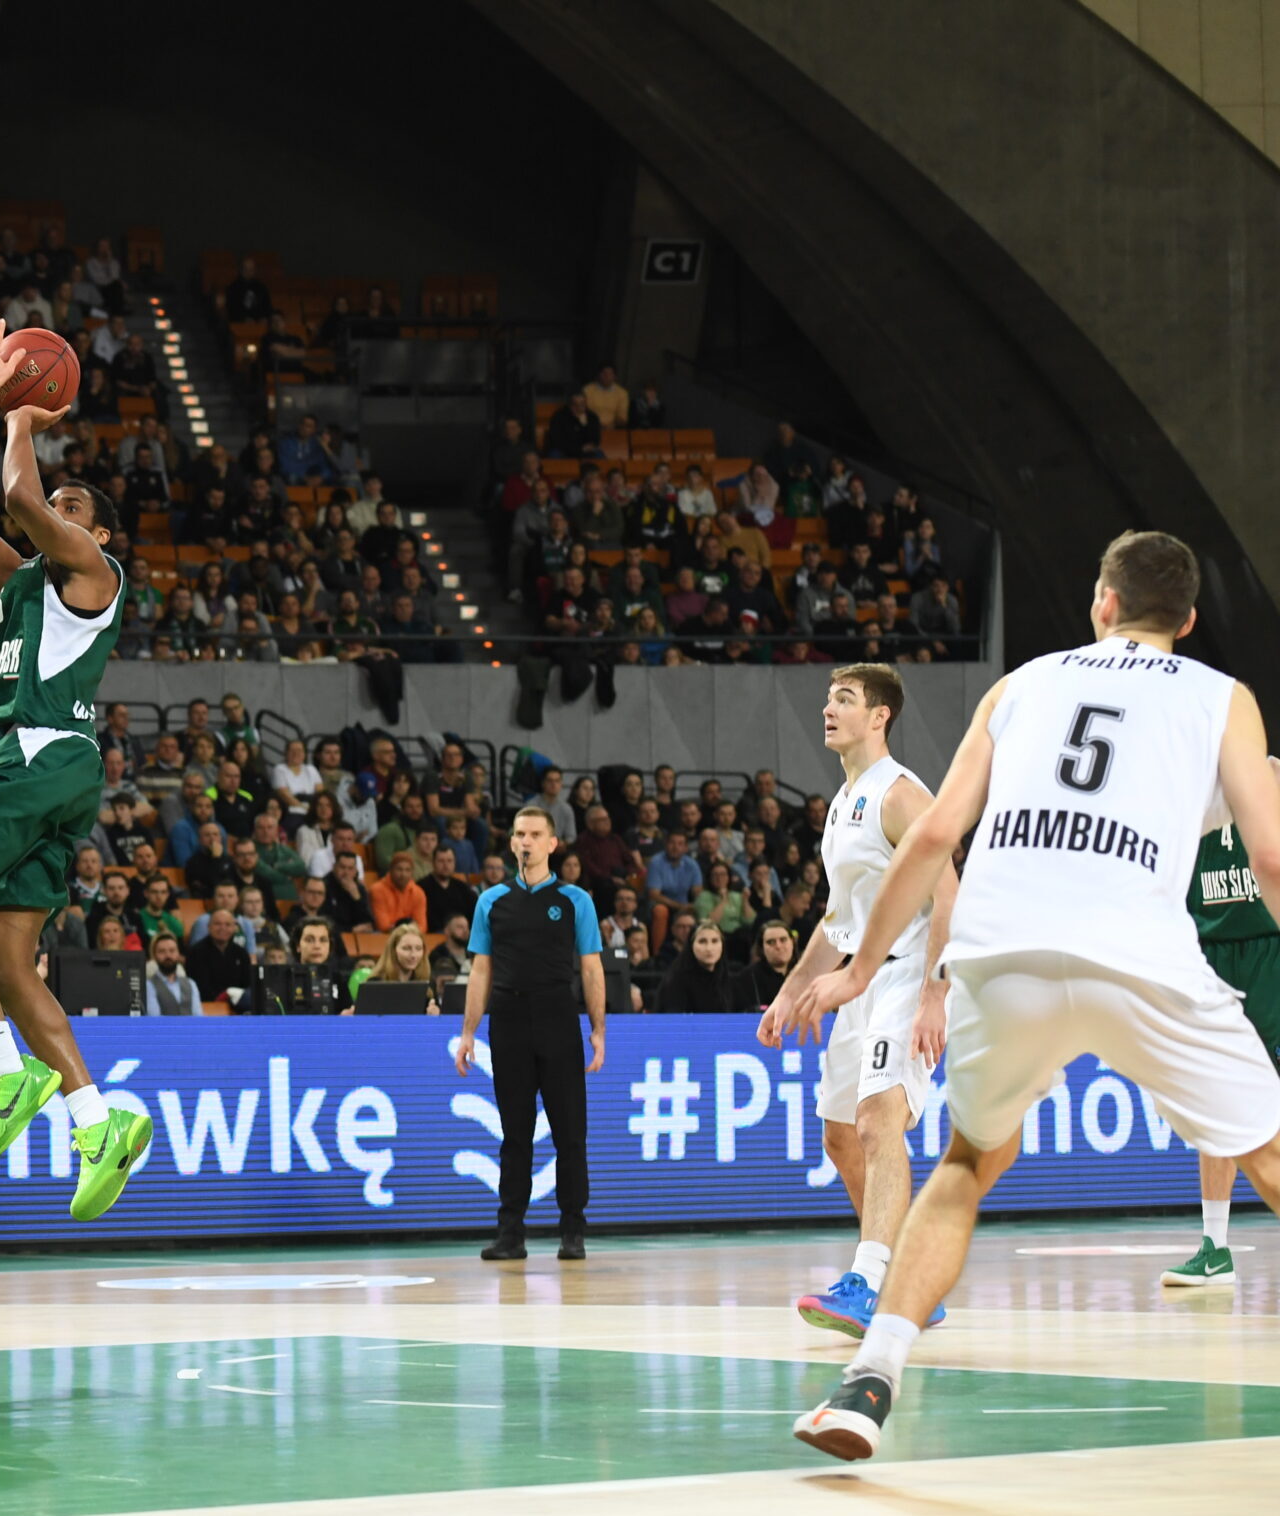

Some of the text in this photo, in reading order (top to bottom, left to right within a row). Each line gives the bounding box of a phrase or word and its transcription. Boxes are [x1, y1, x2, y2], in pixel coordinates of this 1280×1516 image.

[653, 251, 691, 272] C1
[1061, 653, 1182, 675] PHILIPPS
[1055, 702, 1126, 796] 5
[988, 808, 1160, 874] HAMBURG
[1220, 822, 1234, 851] 4
[1200, 869, 1229, 900] WKS
[872, 1040, 889, 1070] 9
